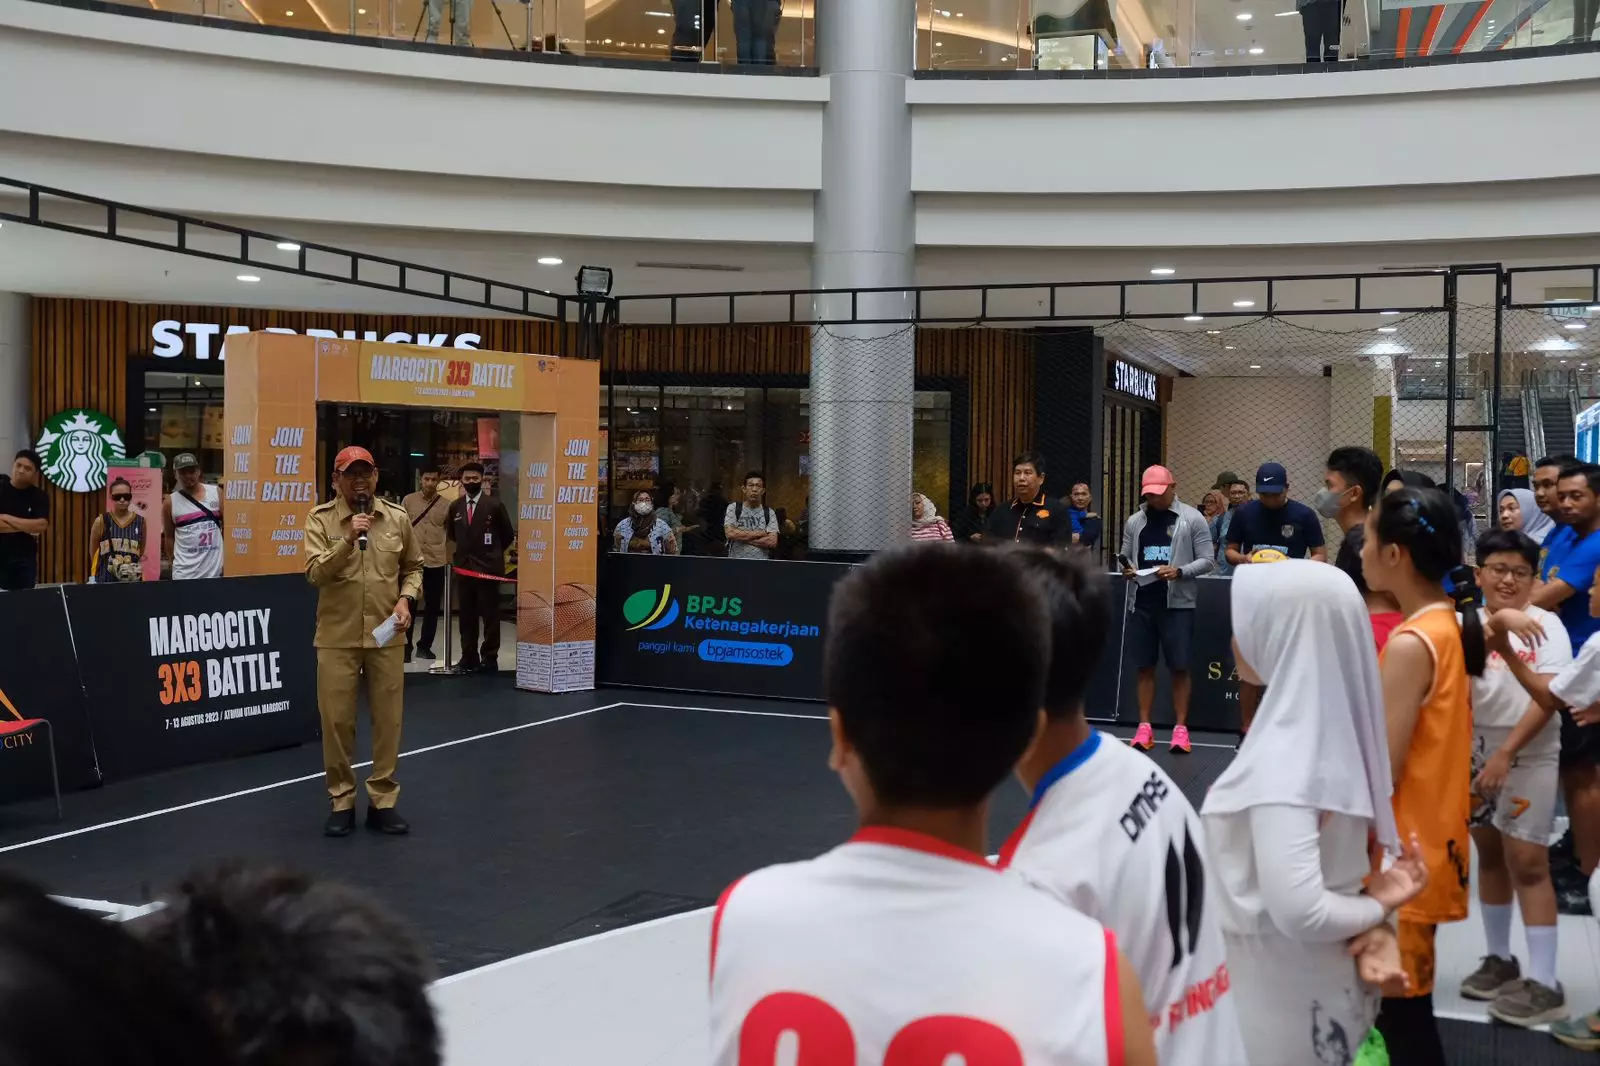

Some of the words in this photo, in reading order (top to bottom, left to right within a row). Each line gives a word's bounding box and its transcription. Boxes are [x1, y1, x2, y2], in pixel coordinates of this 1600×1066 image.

[370, 353, 446, 384] MARGOCITY
[446, 360, 471, 386] 3X3
[471, 362, 516, 388] BATTLE
[1115, 360, 1156, 401] STARBUCKS
[231, 425, 252, 445] JOIN
[270, 427, 304, 447] JOIN
[564, 439, 590, 457] JOIN
[234, 452, 250, 473] THE
[275, 455, 301, 475] THE
[527, 462, 548, 478] JOIN
[568, 462, 587, 480] THE
[226, 480, 258, 500] BATTLE
[261, 481, 312, 502] BATTLE
[529, 483, 545, 499] THE
[558, 486, 596, 504] BATTLE
[279, 514, 296, 526] 7-13
[520, 504, 552, 520] BATTLE
[271, 529, 304, 541] AGUSTUS
[277, 544, 297, 556] 2023
[686, 595, 743, 616] BPJS
[149, 607, 271, 657] MARGOCITY
[684, 615, 820, 638] Ketenagakerjaan
[638, 641, 671, 654] panggil
[673, 641, 695, 653] kami
[706, 642, 784, 662] bpjamsostek
[158, 660, 202, 705] 3X3
[206, 651, 283, 699] BATTLE
[180, 713, 204, 727] AGUSTUS
[204, 711, 219, 723] 2023
[224, 707, 243, 720] ATRIUM
[243, 705, 261, 717] UTAMA
[261, 700, 290, 714] MARGOCITY
[0, 733, 33, 749] CITY
[1119, 771, 1169, 844] DIMAS
